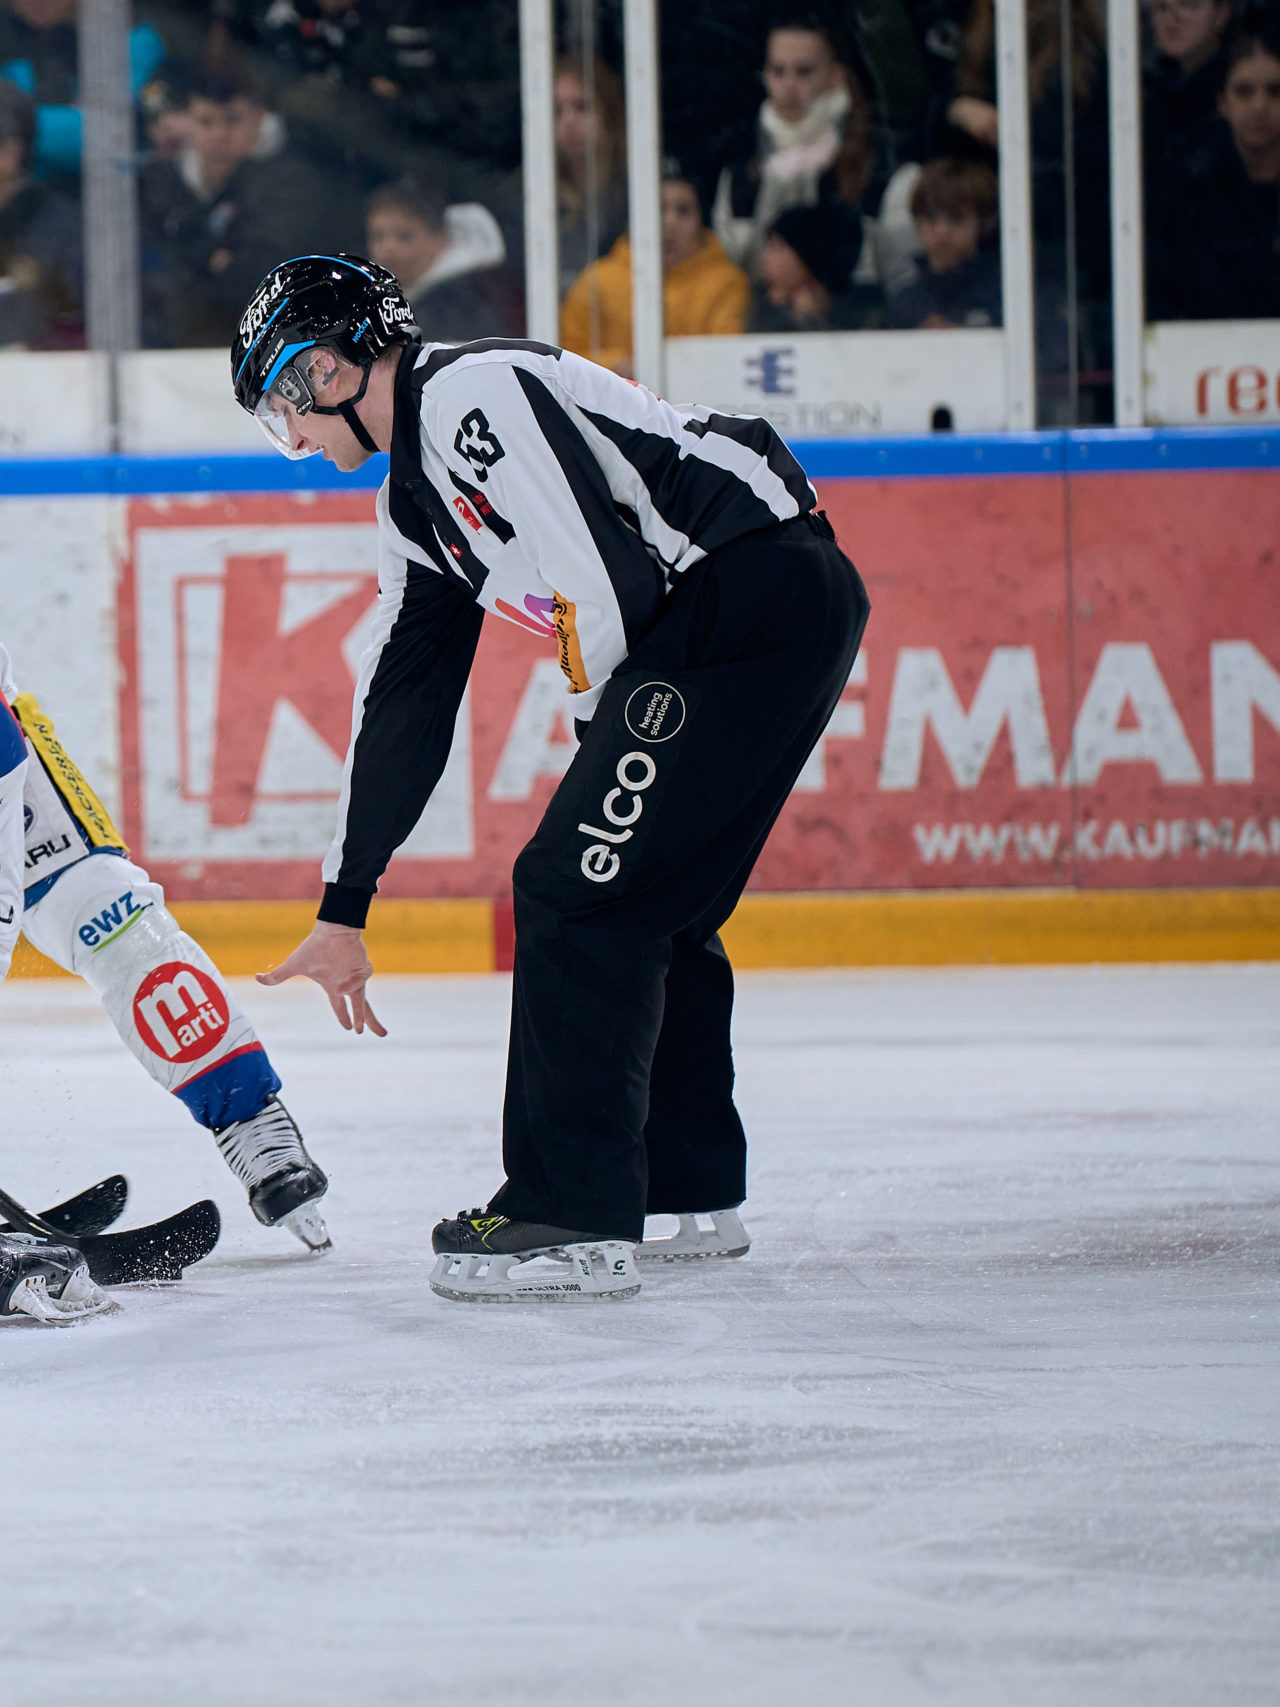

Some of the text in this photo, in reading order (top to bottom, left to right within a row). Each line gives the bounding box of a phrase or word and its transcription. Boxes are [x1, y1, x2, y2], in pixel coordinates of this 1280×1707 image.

[239, 272, 291, 349] Ford
[352, 318, 369, 343] HOCKEY
[382, 296, 413, 324] Ford
[260, 338, 285, 377] TRUE
[1194, 363, 1280, 420] re
[639, 692, 663, 729] heating
[650, 692, 673, 736] solutions
[577, 751, 657, 883] elco
[78, 891, 141, 947] ewz
[563, 1283, 582, 1292] 5000
